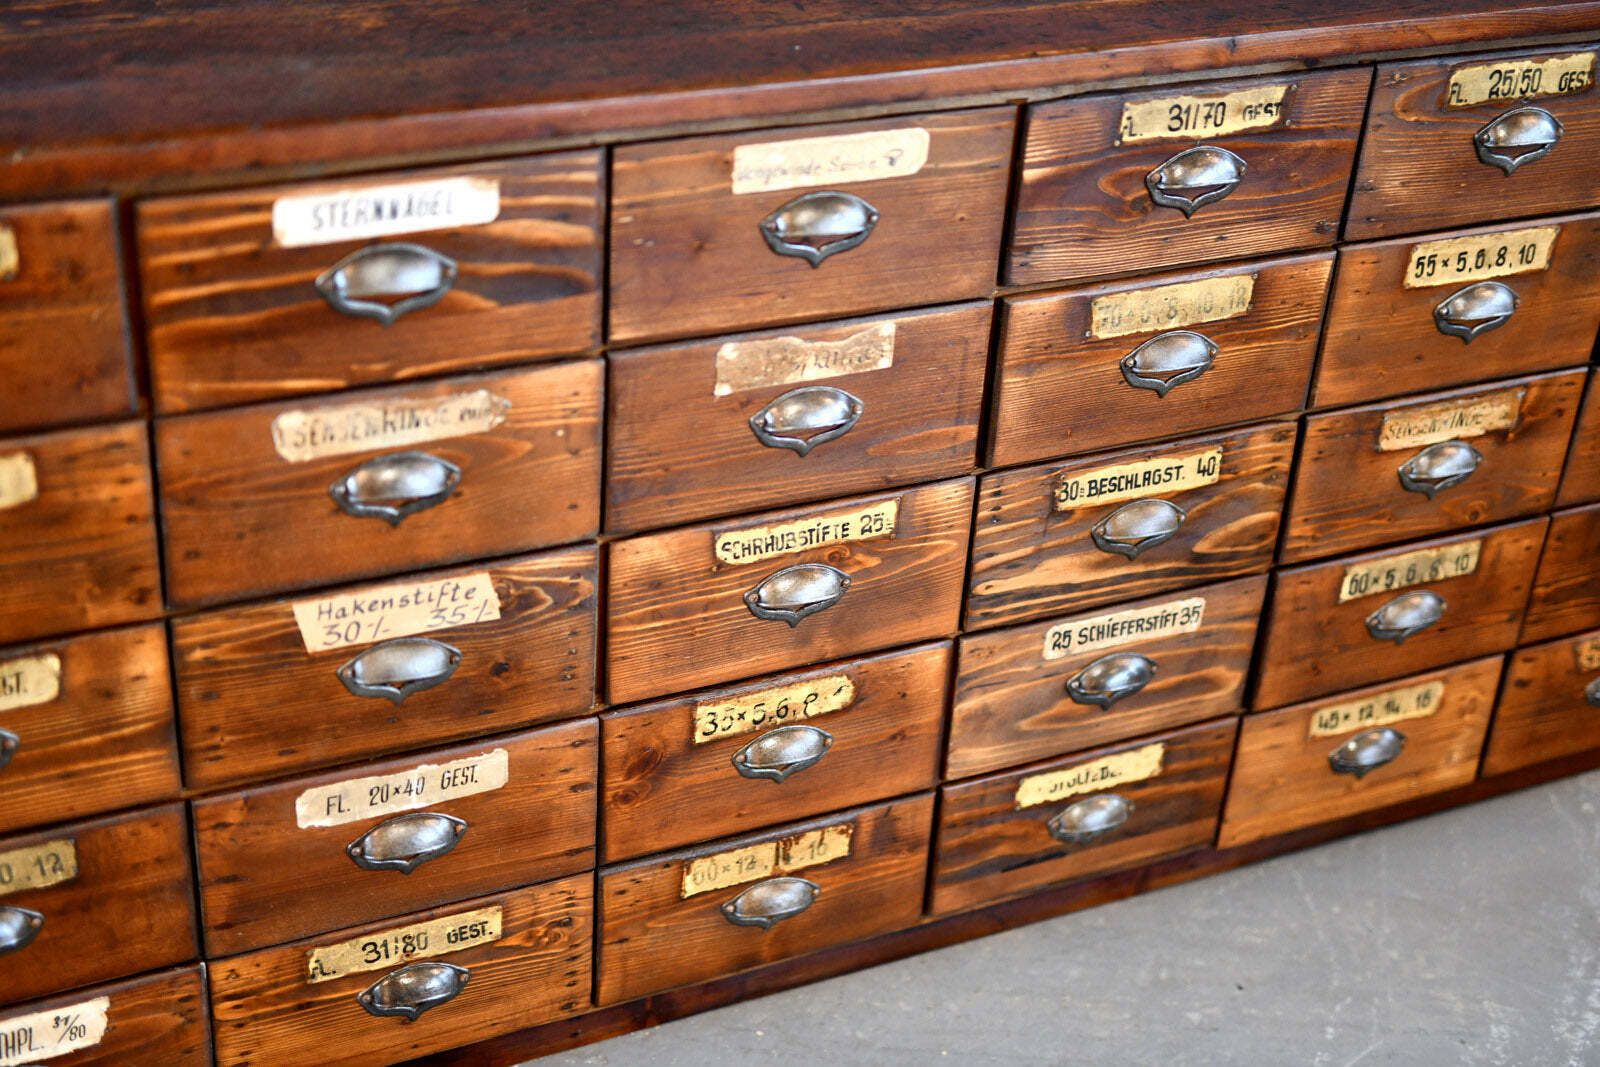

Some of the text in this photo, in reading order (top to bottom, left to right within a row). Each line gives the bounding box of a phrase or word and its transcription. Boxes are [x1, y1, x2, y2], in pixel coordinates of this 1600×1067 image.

[1196, 456, 1216, 477] 40
[317, 582, 477, 621] Hakenstifte
[1052, 630, 1072, 650] 25
[1078, 610, 1179, 645] SCHIEFERSTIFT
[326, 794, 350, 816] FL.
[440, 764, 479, 790] GEST.
